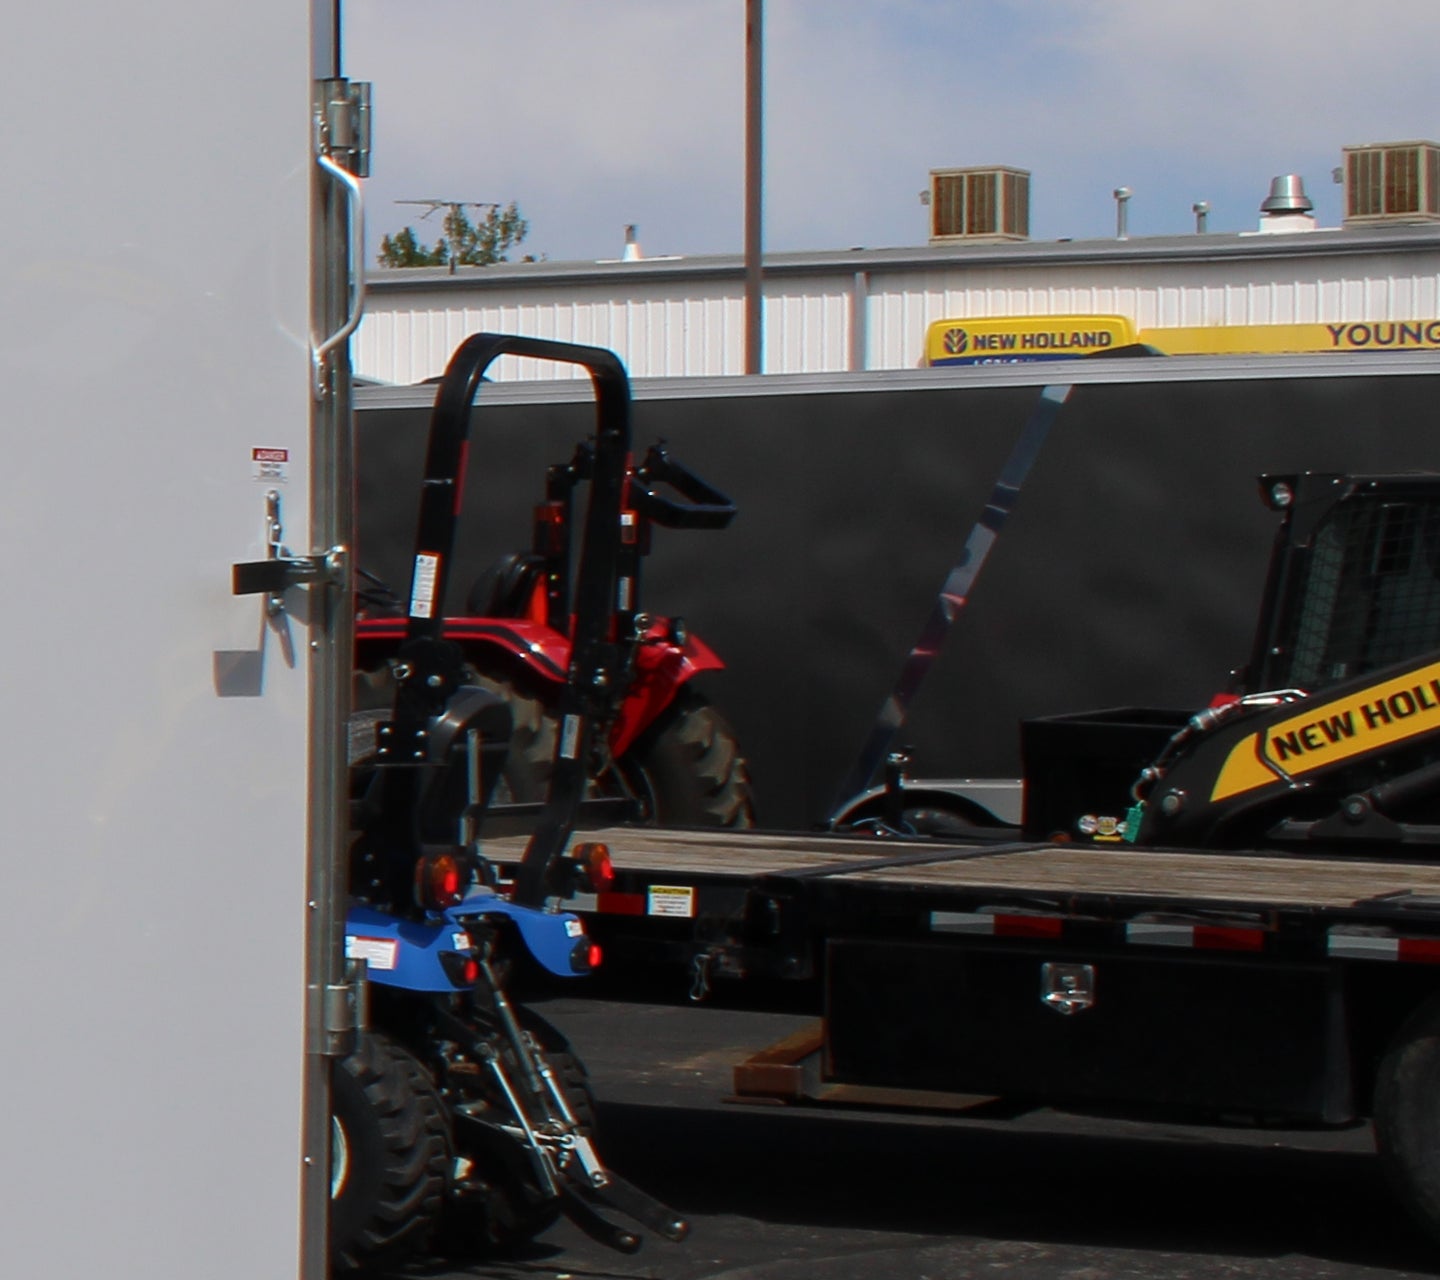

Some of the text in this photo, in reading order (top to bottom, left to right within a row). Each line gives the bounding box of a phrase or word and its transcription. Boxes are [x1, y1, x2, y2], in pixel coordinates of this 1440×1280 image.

[973, 331, 1112, 350] NEW HOLLAND
[1272, 710, 1355, 761] NEW
